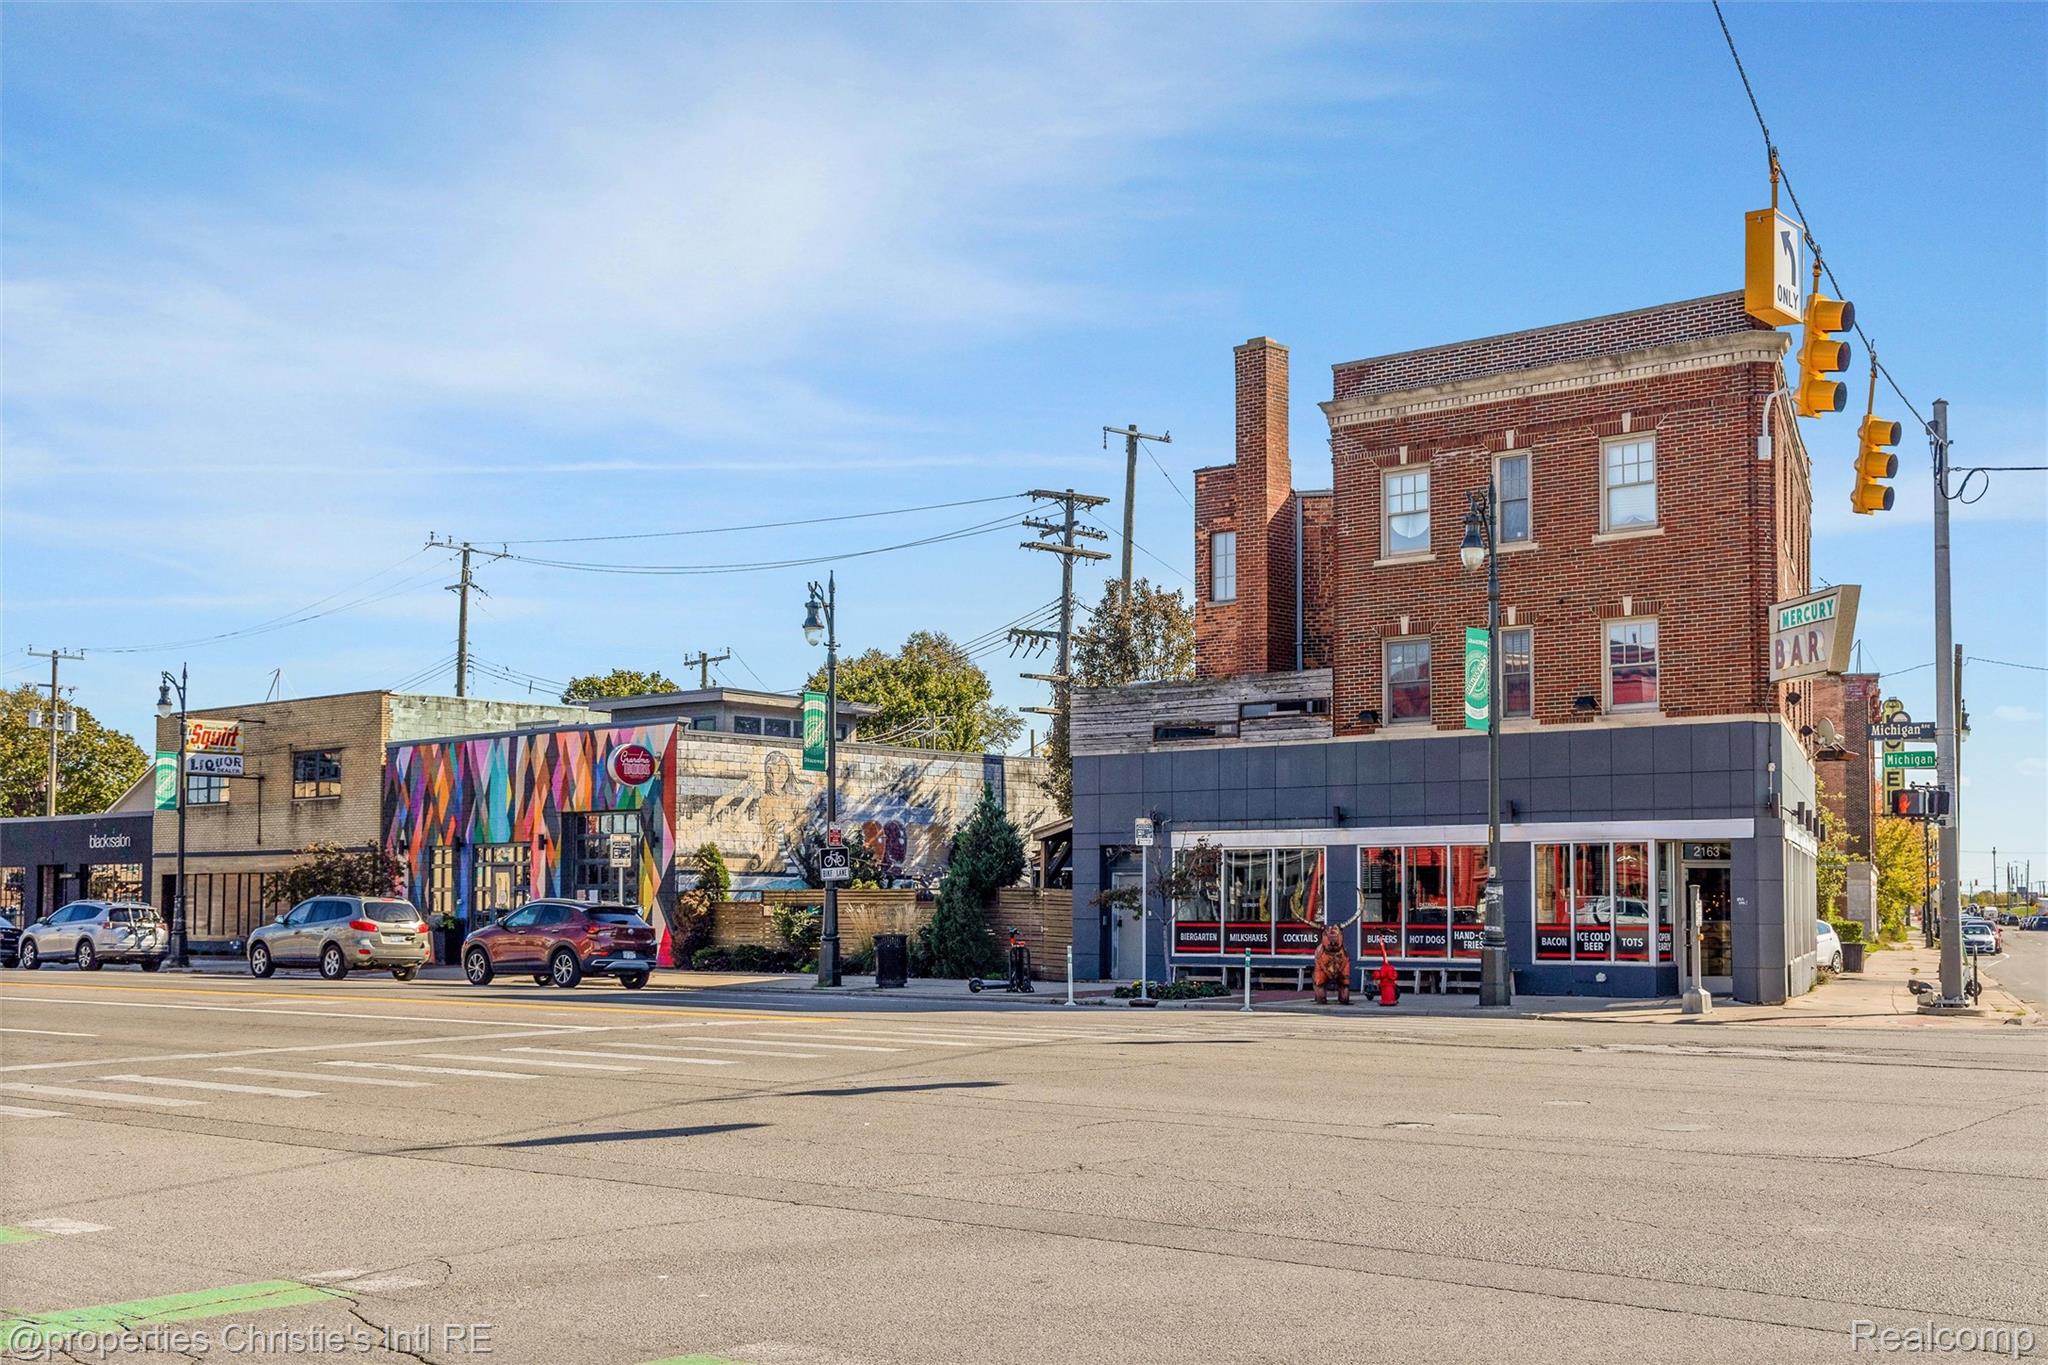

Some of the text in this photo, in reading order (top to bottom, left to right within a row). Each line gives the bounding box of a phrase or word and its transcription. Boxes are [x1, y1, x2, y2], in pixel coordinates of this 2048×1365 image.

[1777, 284, 1799, 310] ONLY
[1782, 599, 1834, 628] MERCURY
[1775, 630, 1822, 670] BAR
[1871, 724, 1921, 737] Michigan
[191, 724, 240, 749] Squirt
[190, 756, 242, 772] LIQUOR
[1887, 754, 1933, 767] Michigan
[1693, 846, 1720, 857] 2163
[823, 868, 848, 878] BIKE LANE
[1180, 932, 1217, 941] BIERGARTEN
[1229, 933, 1268, 943] MILKSHAKES
[1282, 933, 1319, 943] COCKTAILS
[1409, 935, 1446, 944] HOT DOGS
[1454, 931, 1486, 940] HAND-C
[1576, 932, 1611, 942] ICE COLD
[1659, 933, 1671, 941] OPEN
[1463, 940, 1485, 949] FRIES
[1541, 937, 1568, 946] BACON
[1583, 942, 1604, 951] BEER
[1621, 938, 1644, 947] TOTS
[1658, 942, 1672, 951] EARLY
